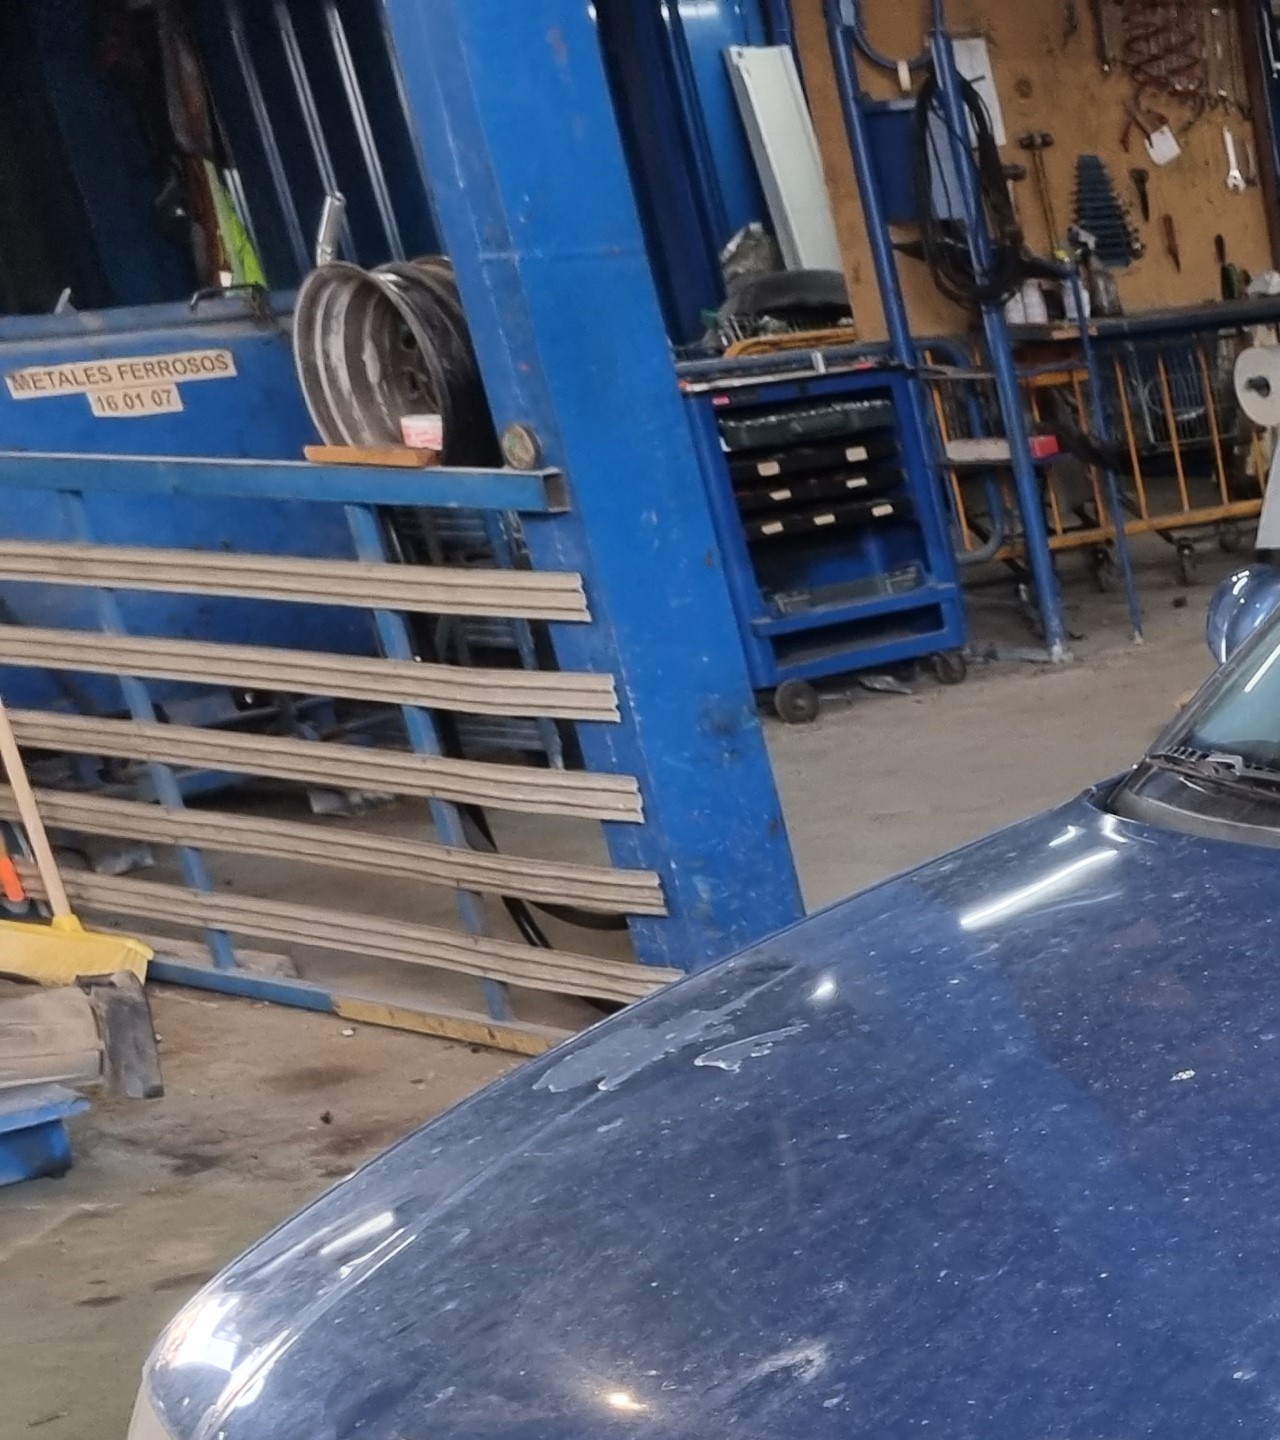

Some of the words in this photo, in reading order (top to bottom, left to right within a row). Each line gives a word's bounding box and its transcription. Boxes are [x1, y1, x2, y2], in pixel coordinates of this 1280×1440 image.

[10, 366, 112, 392] METALES
[119, 353, 229, 382] FERROSOS
[97, 395, 118, 412] 16
[123, 392, 144, 411] 01
[152, 389, 172, 407] 07
